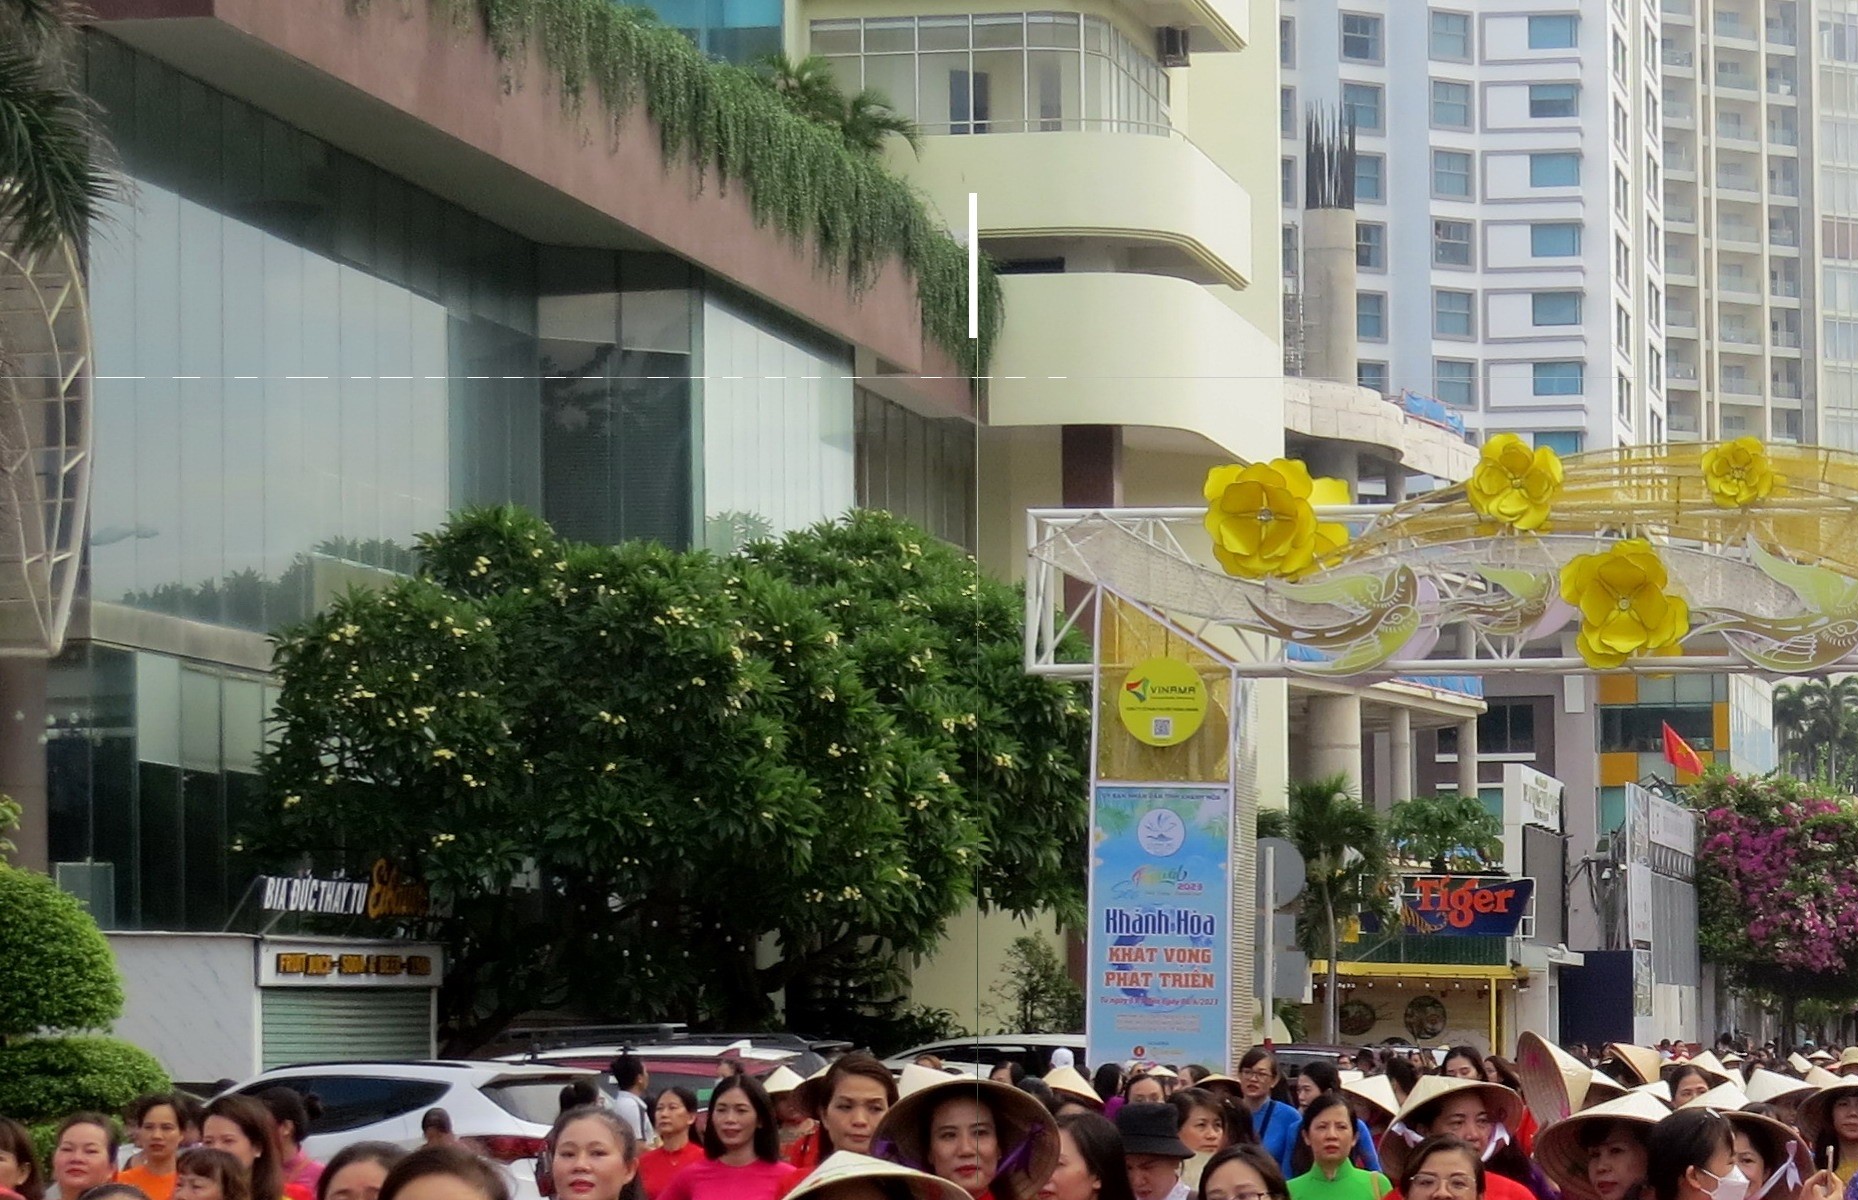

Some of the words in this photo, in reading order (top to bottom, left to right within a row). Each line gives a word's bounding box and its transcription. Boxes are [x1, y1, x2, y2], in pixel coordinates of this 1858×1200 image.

[1150, 686, 1196, 694] VINAMA
[263, 877, 287, 911] BIA
[288, 868, 319, 912] ĐỨC
[350, 882, 369, 915] TU
[1177, 882, 1203, 891] 2023
[1413, 875, 1516, 928] Tiger
[1105, 908, 1170, 935] Khánh
[1176, 909, 1215, 936] Hòa
[1108, 943, 1158, 963] KHÁT
[1165, 948, 1212, 967] VỌNG
